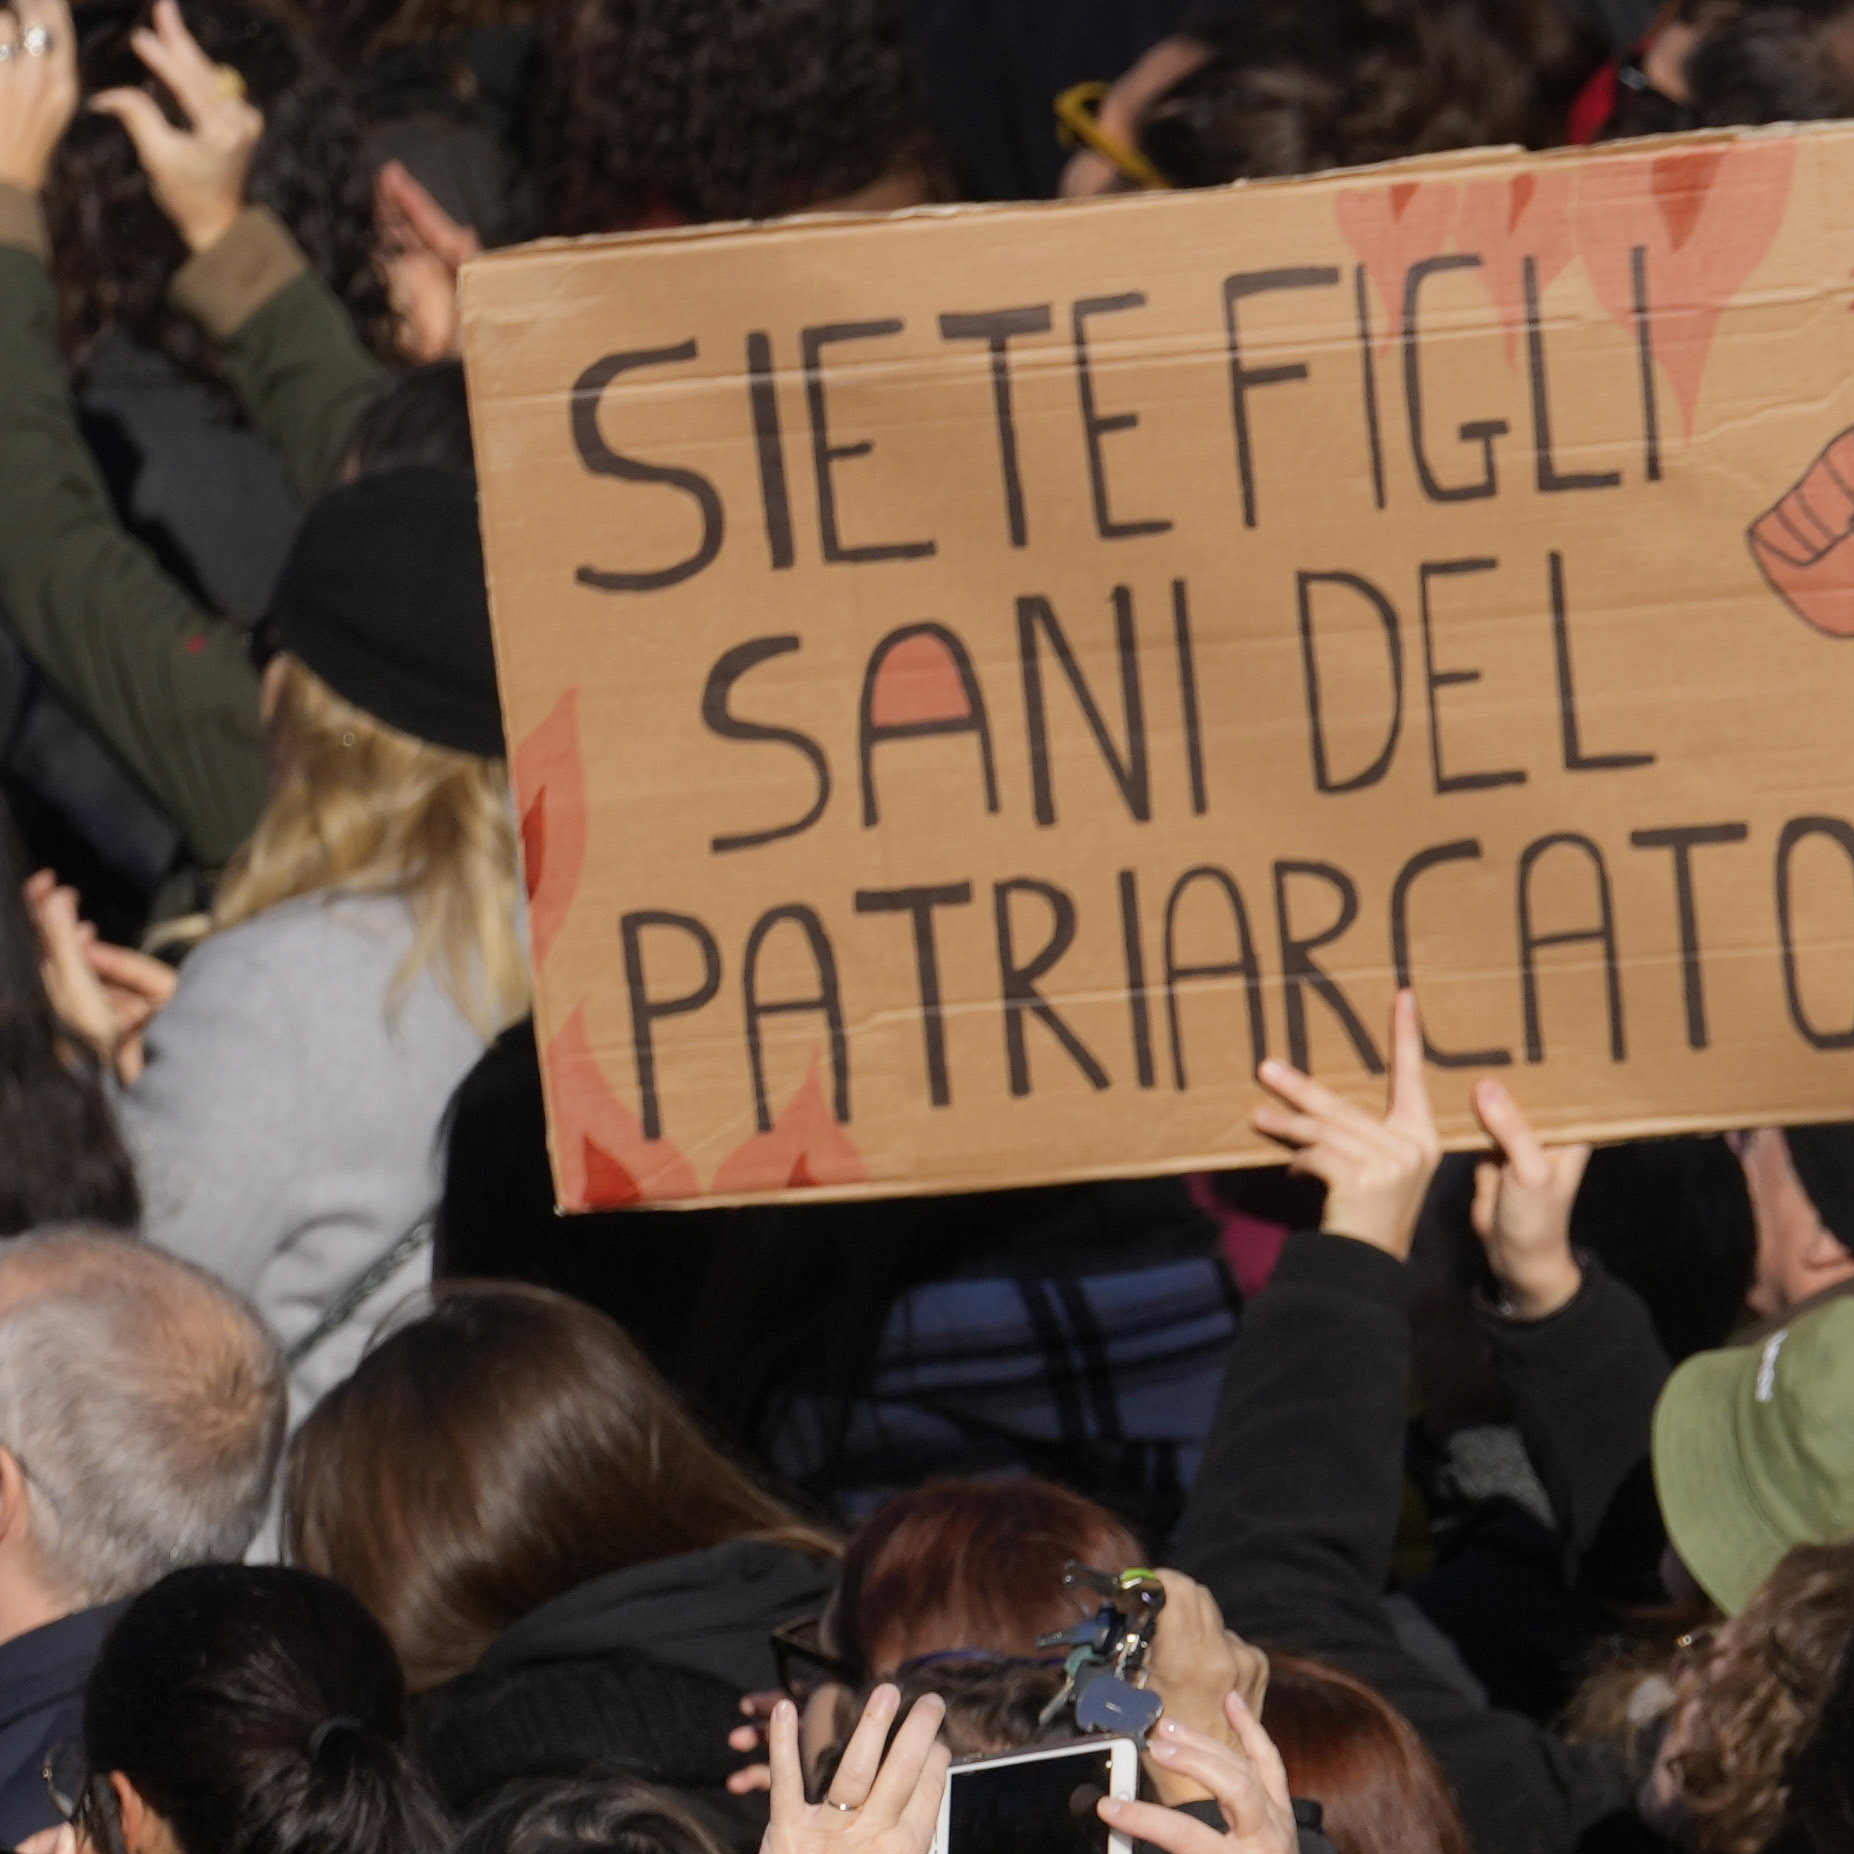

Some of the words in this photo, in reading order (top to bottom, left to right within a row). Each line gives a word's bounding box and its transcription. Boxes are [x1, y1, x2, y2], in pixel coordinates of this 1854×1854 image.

[570, 292, 1174, 592] SIETE
[1224, 246, 1662, 528] FIGLI
[701, 580, 1207, 854] SANI
[1296, 550, 1655, 796] DEL
